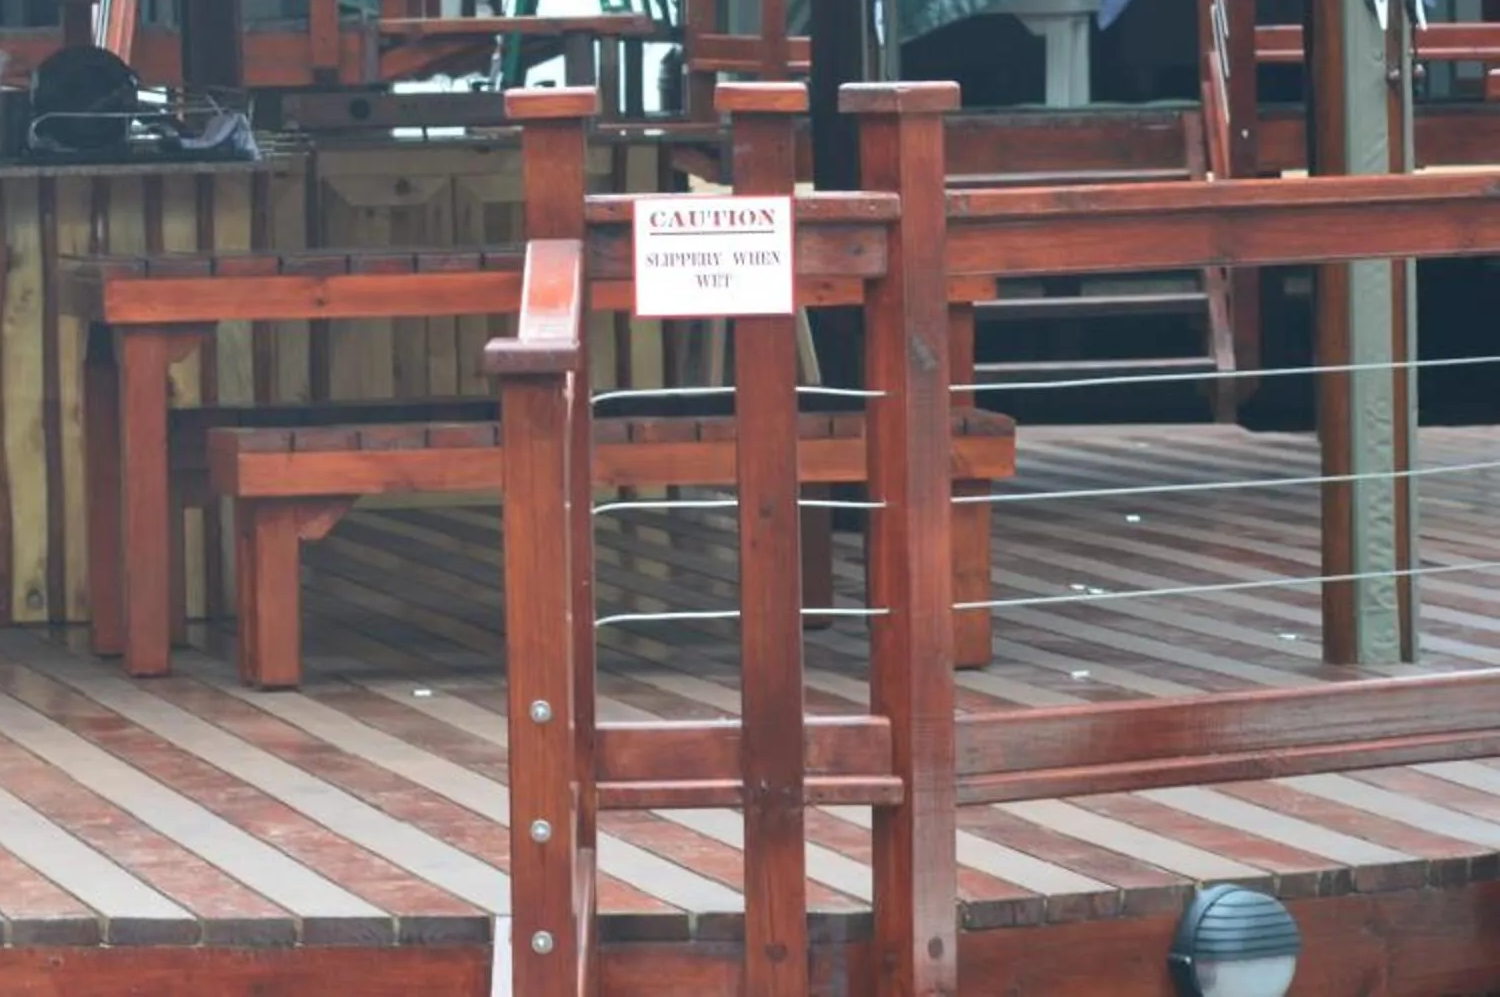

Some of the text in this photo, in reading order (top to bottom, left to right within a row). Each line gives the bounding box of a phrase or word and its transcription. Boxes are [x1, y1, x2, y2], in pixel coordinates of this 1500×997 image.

[649, 208, 776, 228] CAUTION
[645, 251, 782, 268] SLIPPERY WHEN
[695, 274, 732, 289] WET
